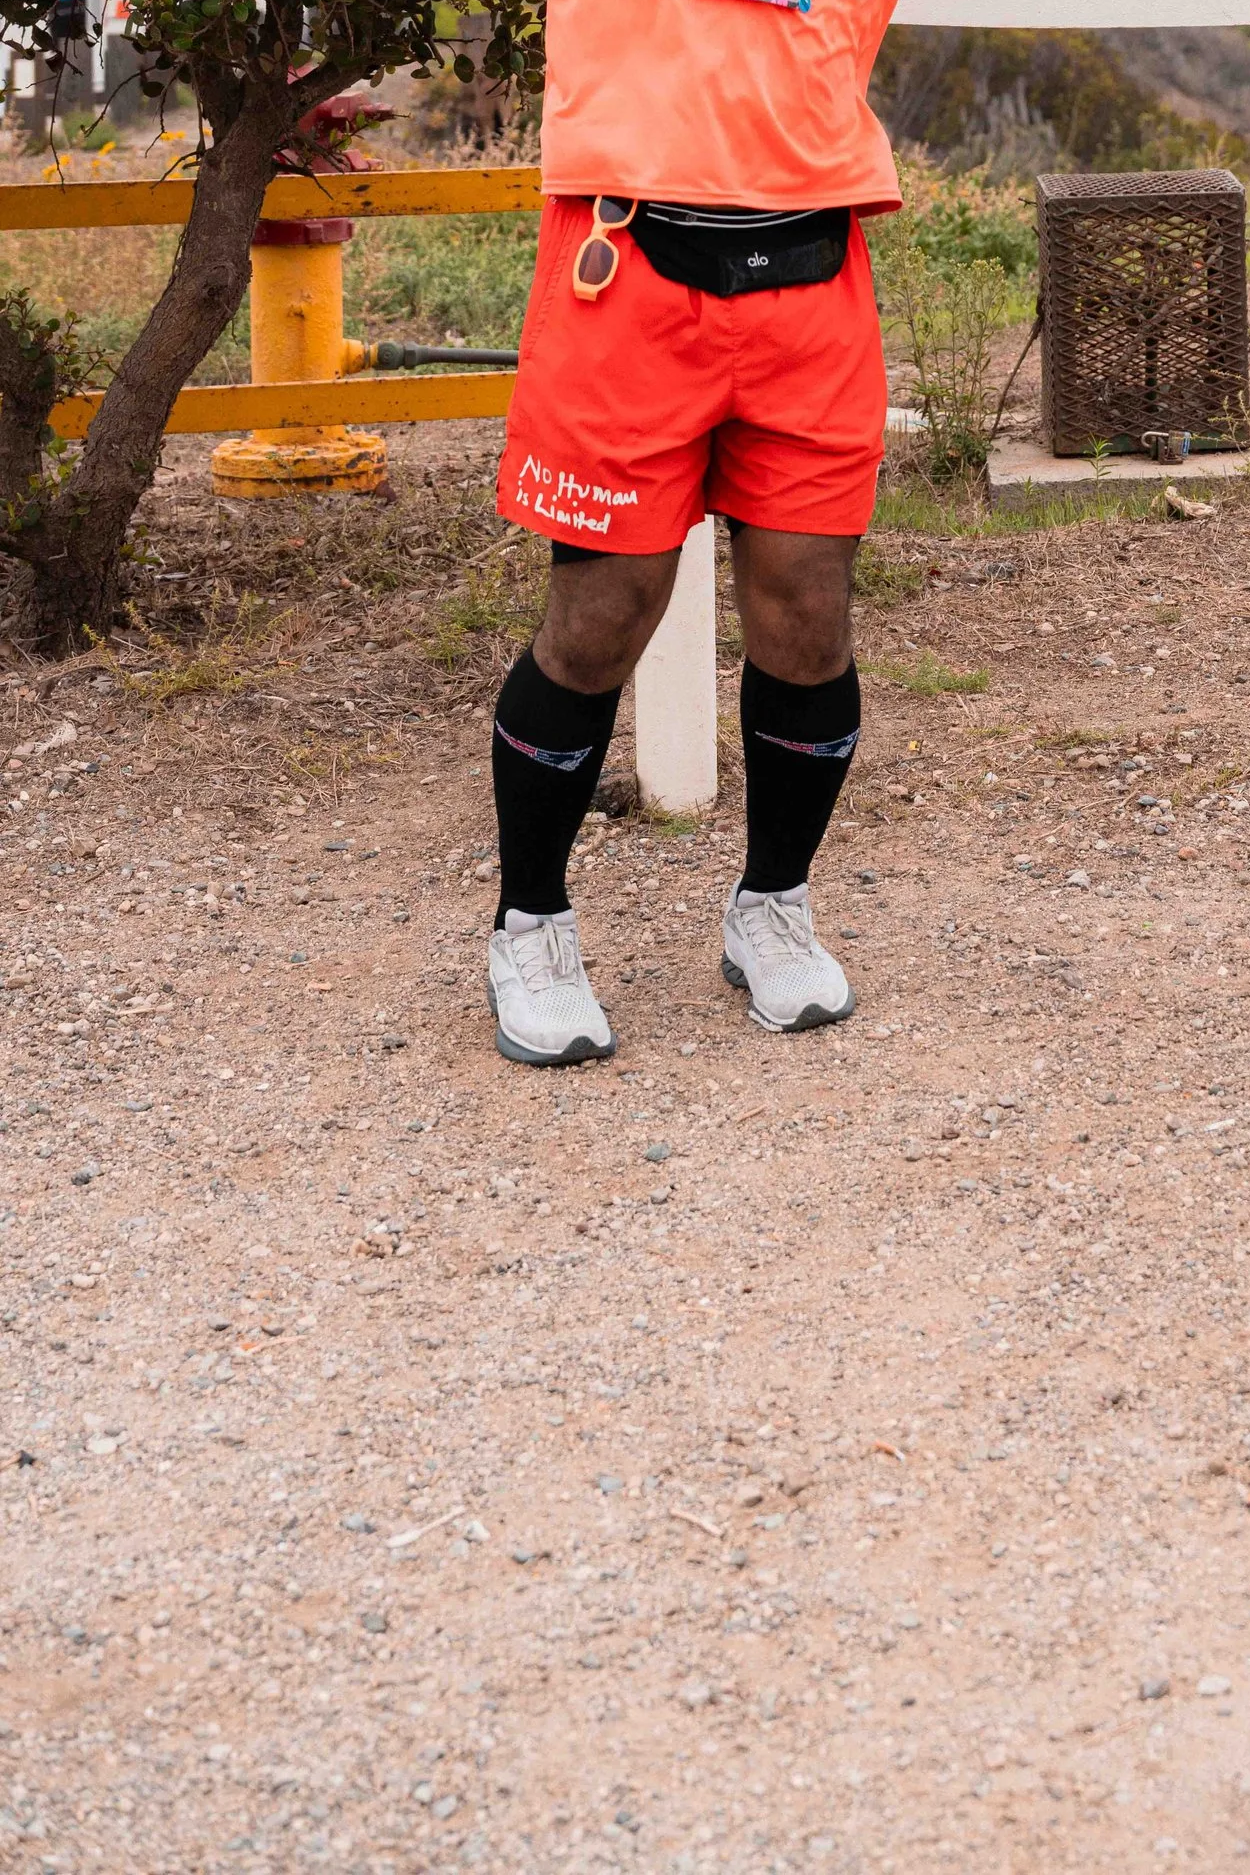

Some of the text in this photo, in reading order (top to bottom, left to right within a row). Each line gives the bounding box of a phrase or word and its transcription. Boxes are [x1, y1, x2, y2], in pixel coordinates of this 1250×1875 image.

[747, 251, 770, 268] alo
[519, 454, 639, 506] No Human
[515, 479, 612, 535] is Limited
